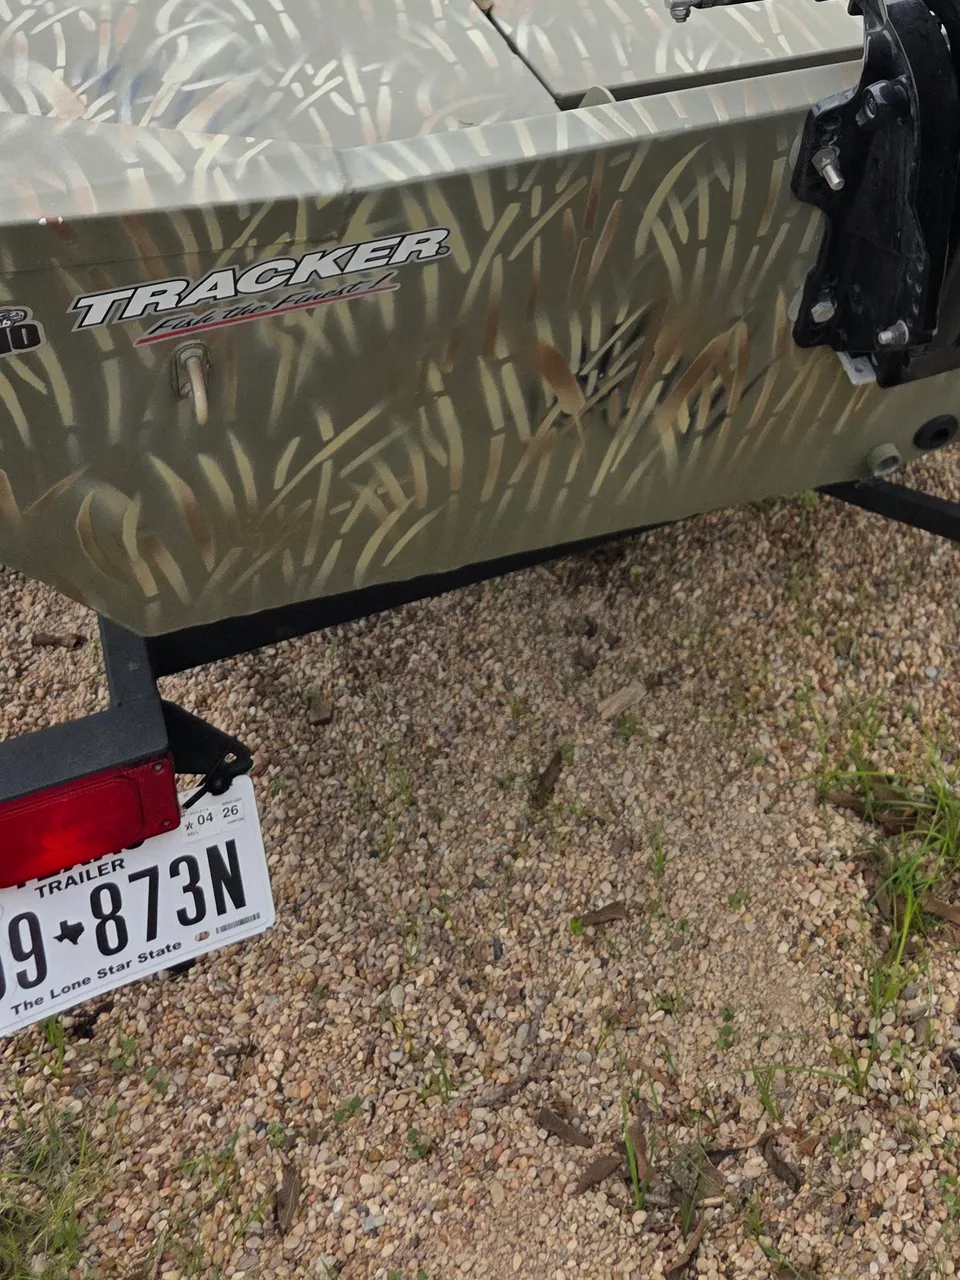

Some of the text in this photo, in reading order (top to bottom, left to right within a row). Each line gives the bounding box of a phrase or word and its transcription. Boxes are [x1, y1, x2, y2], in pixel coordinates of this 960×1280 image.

[148, 314, 215, 335] Fish
[223, 303, 268, 320] the
[197, 812, 213, 825] 04
[222, 805, 239, 818] 26
[34, 857, 126, 899] TRAILER
[0, 911, 48, 1001] 9
[89, 838, 247, 957] 873N
[11, 940, 182, 1016] The Lone Star State
